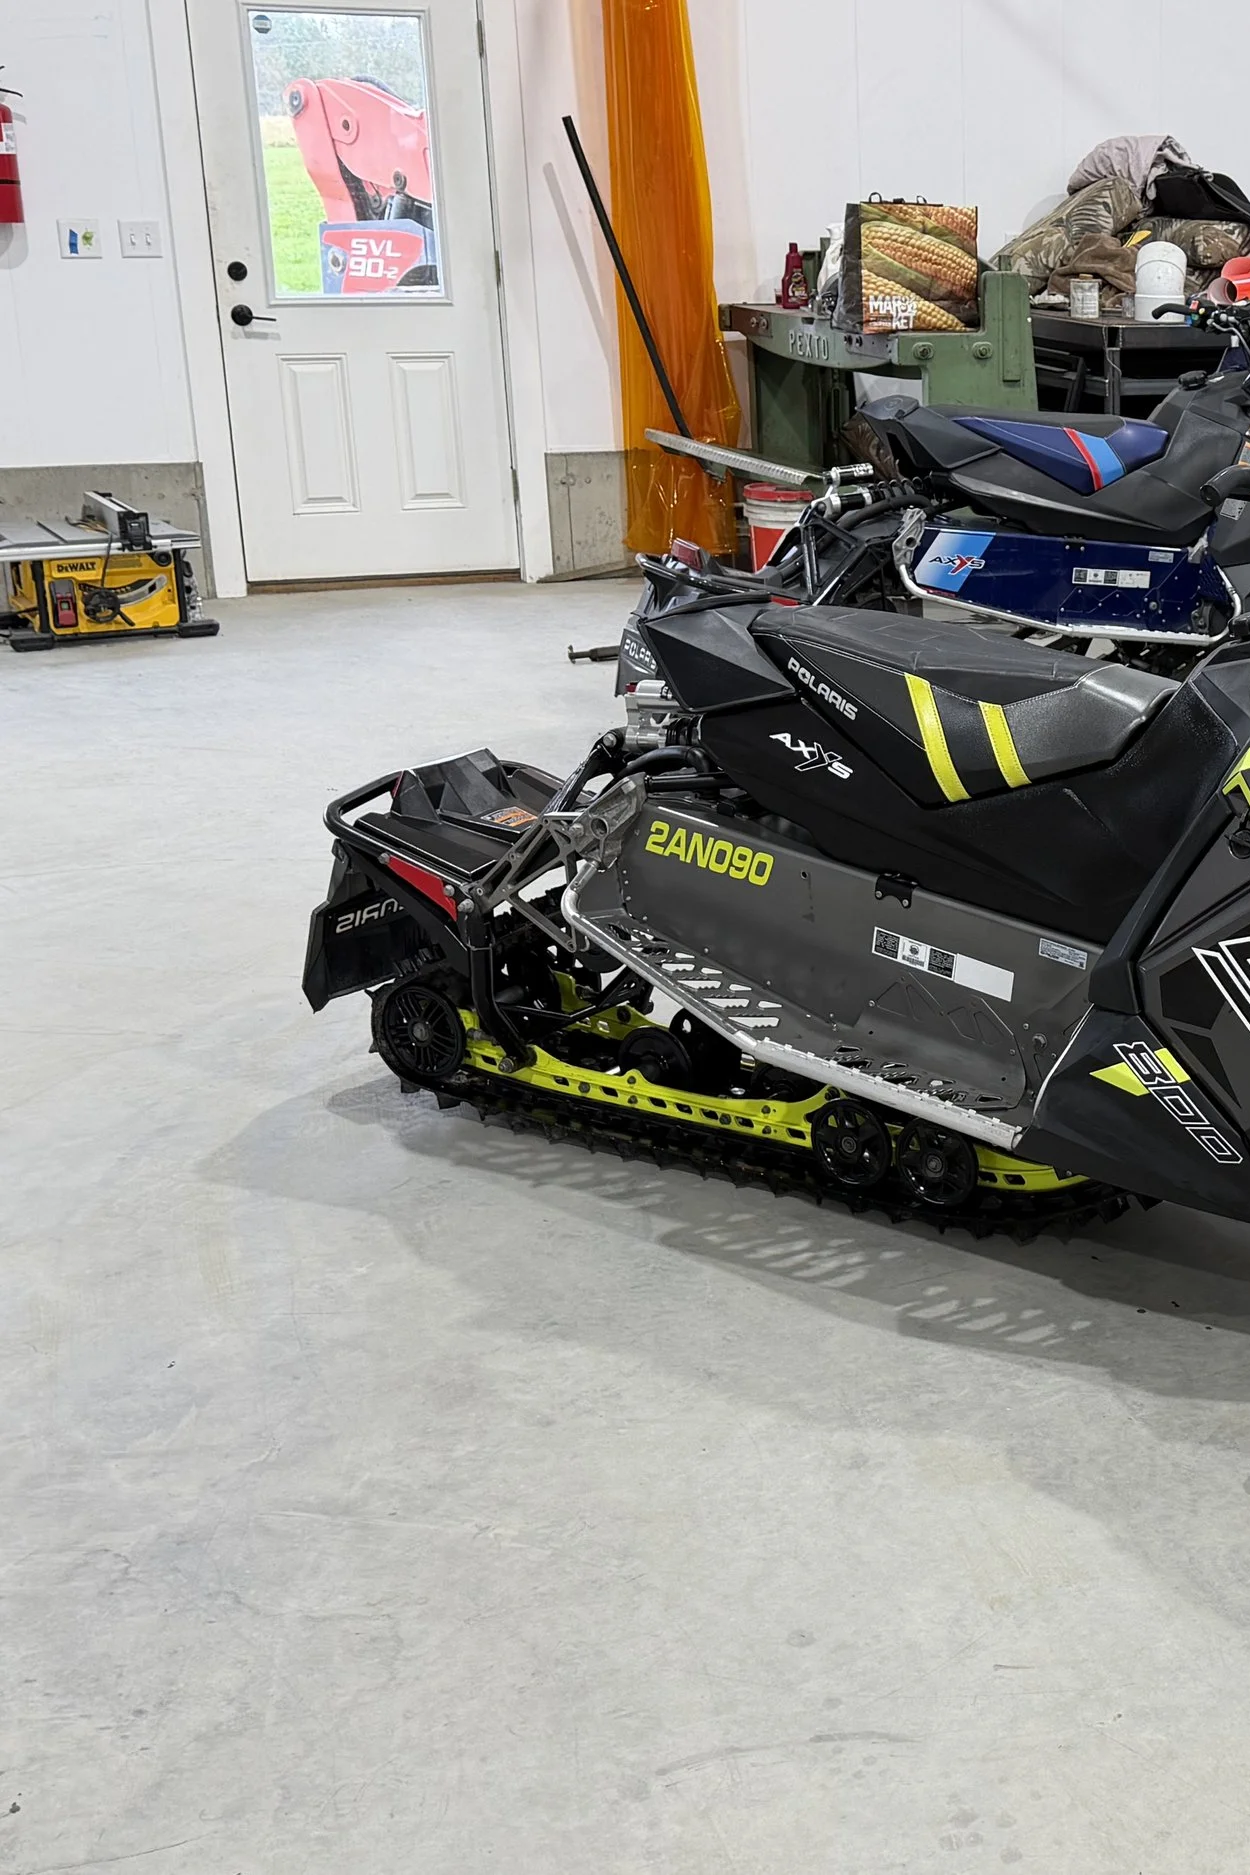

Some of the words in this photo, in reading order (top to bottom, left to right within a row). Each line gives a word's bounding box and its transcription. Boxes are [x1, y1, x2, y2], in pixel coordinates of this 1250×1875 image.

[350, 238, 402, 257] SVL
[349, 257, 399, 279] 90-2
[788, 329, 829, 360] PEXTO
[928, 554, 986, 575] AXYS
[787, 656, 859, 721] POLARIS
[768, 732, 853, 780] AXYS
[645, 820, 774, 886] 2AN090
[1113, 1041, 1243, 1164] 800
